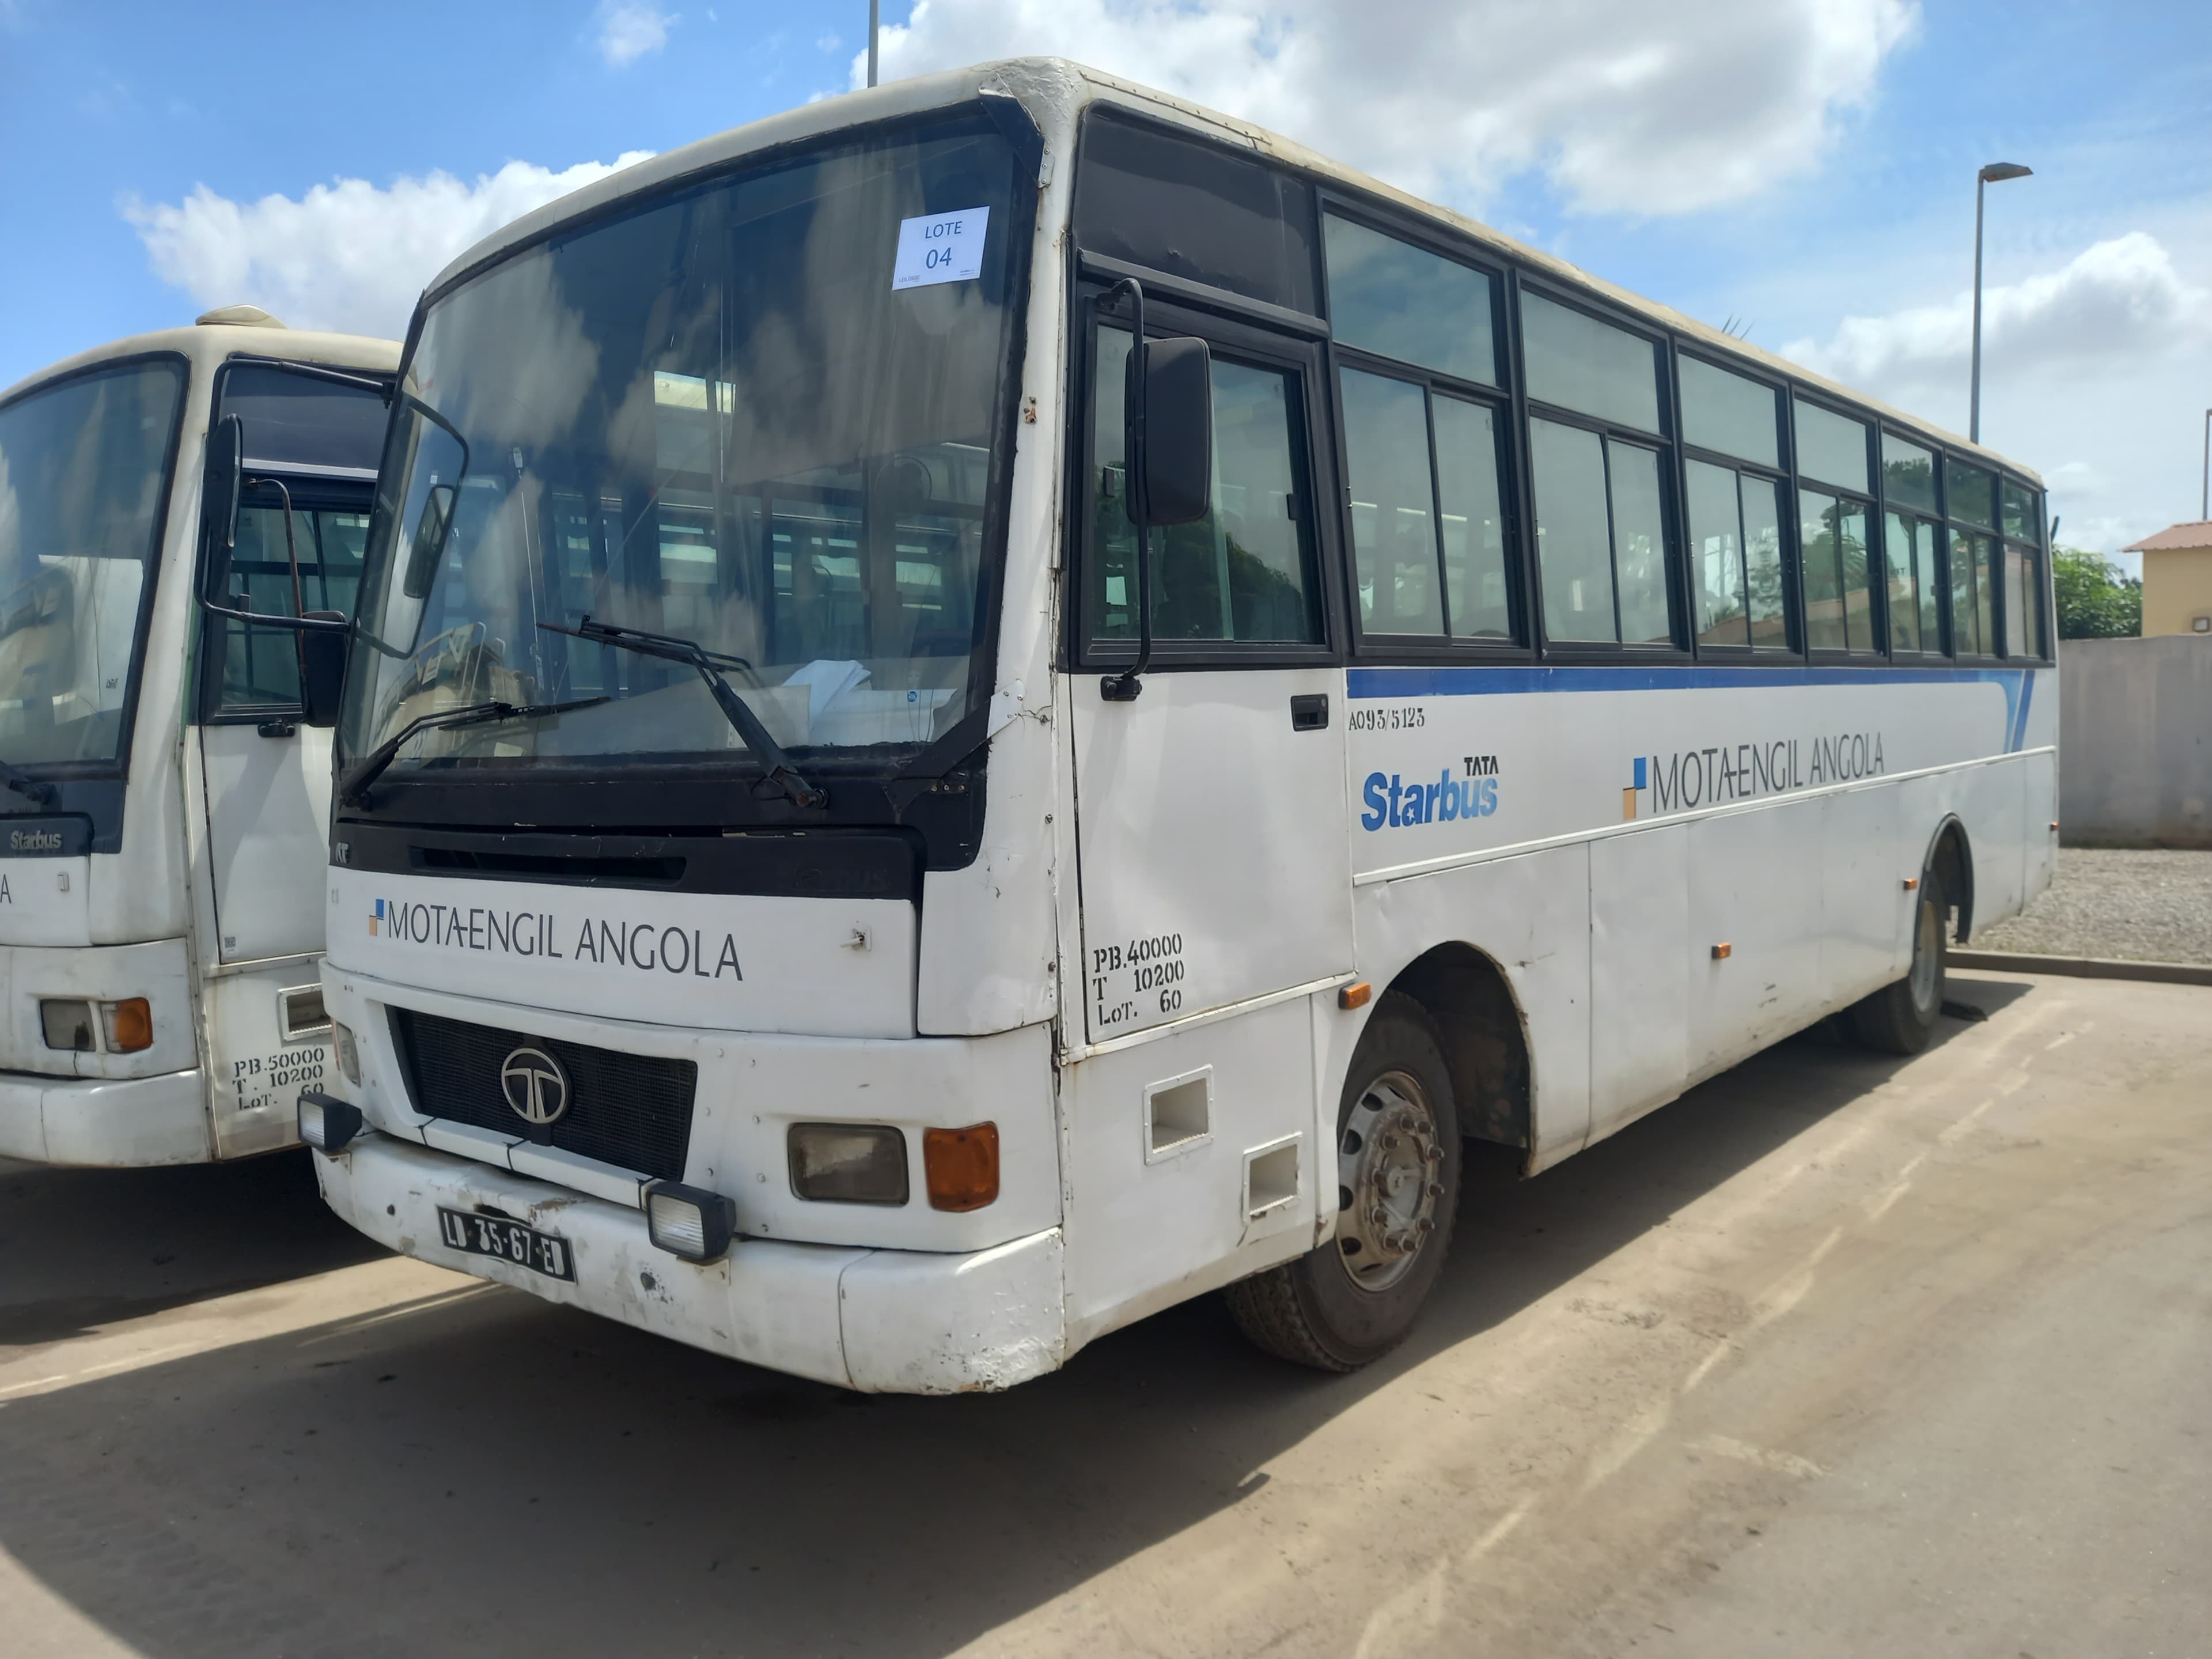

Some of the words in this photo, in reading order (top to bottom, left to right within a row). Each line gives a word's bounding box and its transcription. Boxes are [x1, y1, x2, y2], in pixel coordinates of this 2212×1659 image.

[925, 221, 963, 238] LOTE
[926, 247, 952, 269] 04
[1464, 756, 1499, 776] TATA
[1653, 739, 1803, 813] MOTA-ENGIL
[1810, 732, 1884, 784] ANGOLA
[1361, 768, 1498, 831] Starbus
[11, 830, 62, 850] Starbus
[388, 900, 562, 958] MOTA-ENGIL
[575, 918, 743, 981] ANGOLA
[1093, 933, 1182, 973] PB.40000
[1093, 976, 1107, 1001] T
[1134, 960, 1184, 992] 10200
[1160, 989, 1181, 1013] 60
[234, 1047, 324, 1077] PB.50000
[270, 1064, 323, 1088] 10200
